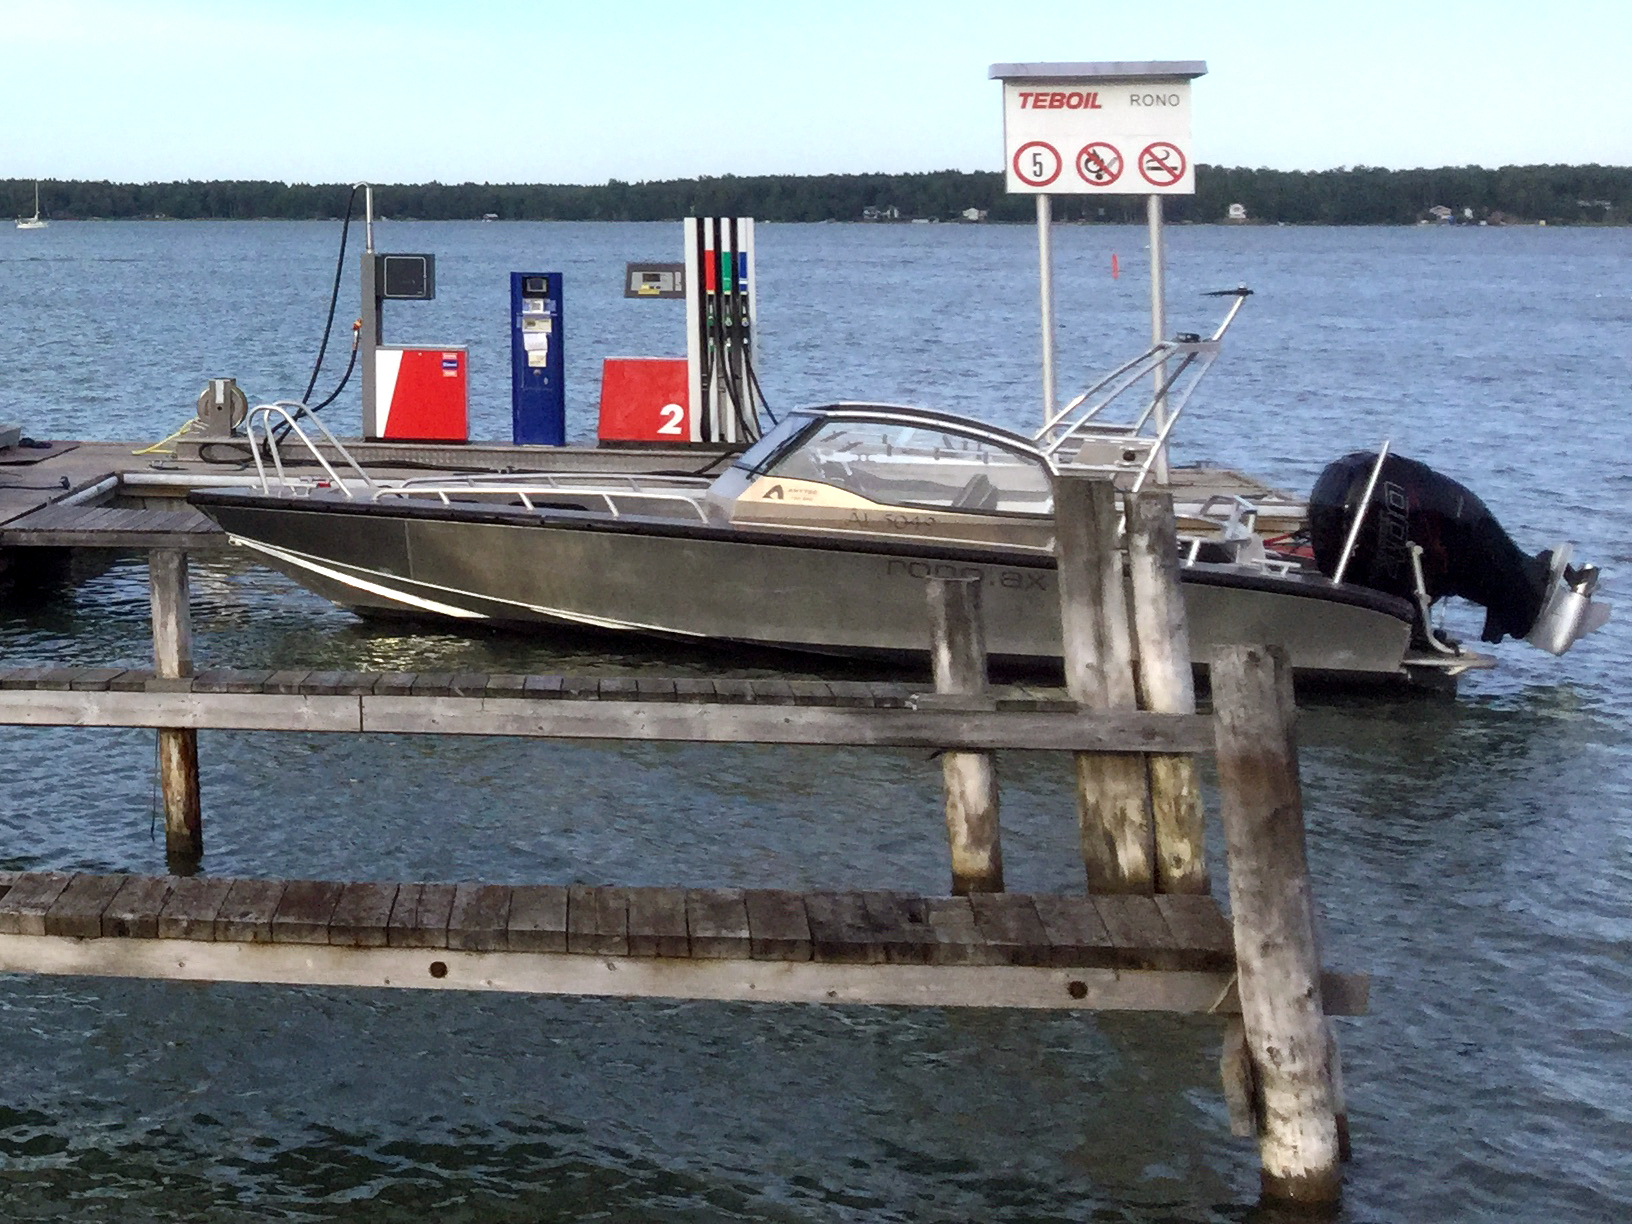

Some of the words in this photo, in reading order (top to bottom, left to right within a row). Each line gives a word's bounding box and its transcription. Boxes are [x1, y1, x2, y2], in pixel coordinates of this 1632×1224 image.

[1018, 92, 1102, 110] TEBOIL
[1129, 94, 1181, 107] RONO
[1032, 152, 1043, 178] 5
[657, 403, 684, 434] 2
